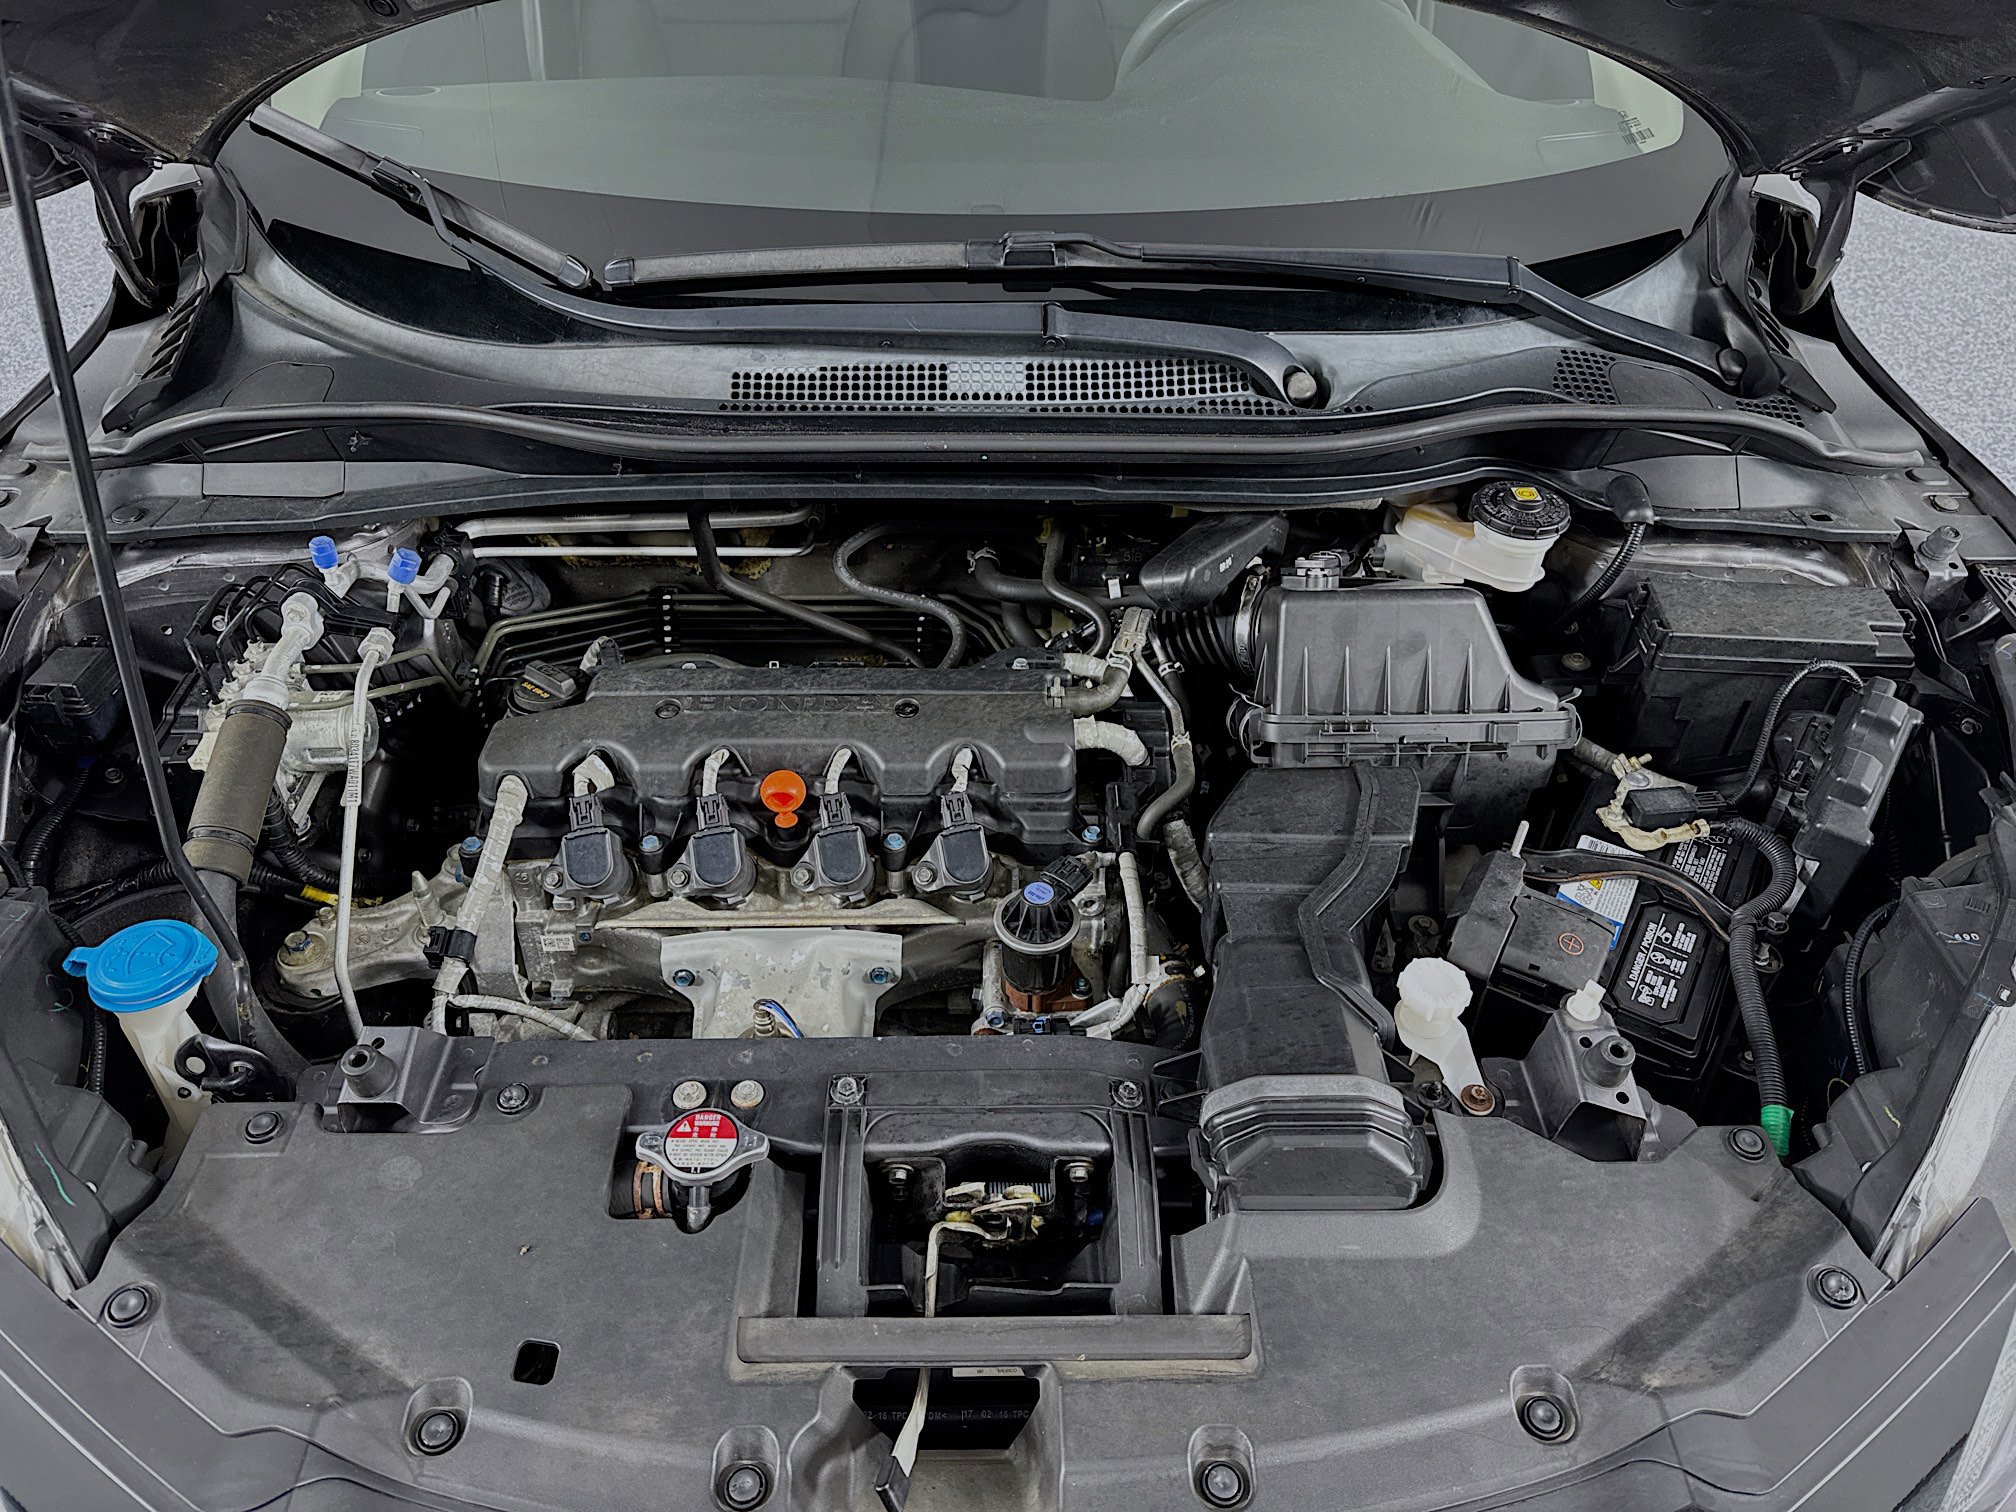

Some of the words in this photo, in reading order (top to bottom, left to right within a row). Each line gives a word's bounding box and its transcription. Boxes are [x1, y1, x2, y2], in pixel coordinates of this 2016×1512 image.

[684, 695, 890, 713] HONDA
[1628, 951, 1647, 982] DANGER
[1641, 921, 1658, 949] POISON
